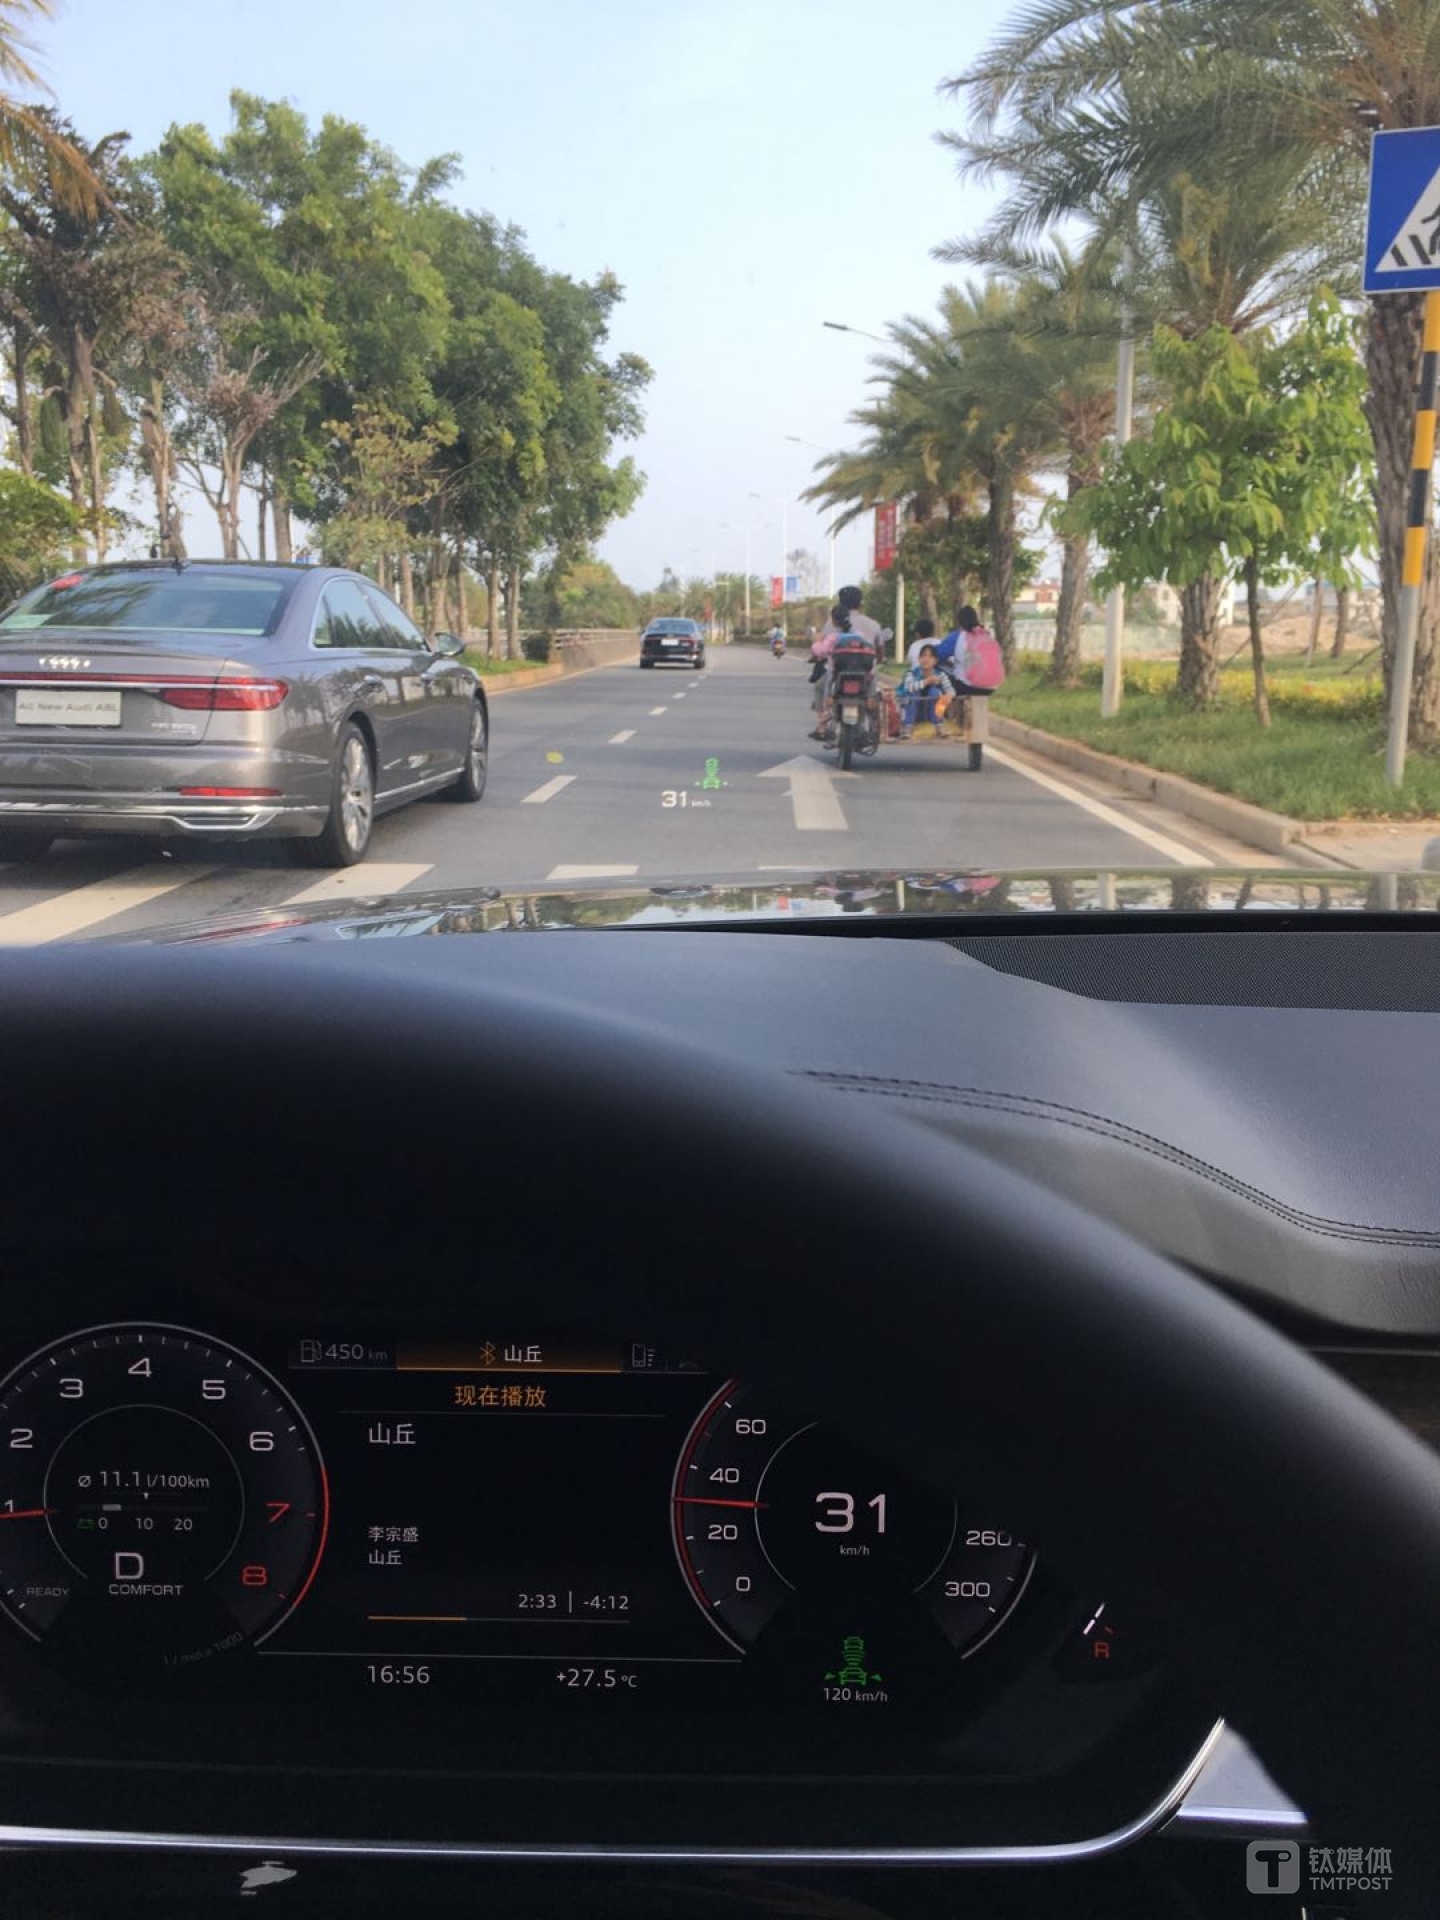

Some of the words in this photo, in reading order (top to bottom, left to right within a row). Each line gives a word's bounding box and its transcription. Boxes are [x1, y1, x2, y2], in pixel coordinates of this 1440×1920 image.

[661, 790, 687, 808] 31
[325, 1343, 364, 1360] 450
[504, 1344, 543, 1363] 山丘
[127, 1357, 153, 1378] 4
[59, 1378, 84, 1399] 3
[202, 1379, 226, 1400] 5
[455, 1385, 546, 1407] 现在播放
[369, 1422, 416, 1445] 山丘
[735, 1418, 766, 1435] 60
[9, 1428, 33, 1449] 2
[249, 1431, 274, 1452] 6
[709, 1467, 740, 1484] 40
[266, 1501, 291, 1522] 7
[815, 1491, 886, 1533] 31
[97, 1516, 108, 1530] 0
[135, 1517, 154, 1530] 10
[174, 1518, 193, 1531] 20
[707, 1524, 738, 1541] 20
[368, 1525, 419, 1542] 李宗盛
[966, 1530, 1012, 1547] 260
[368, 1549, 403, 1565] 山丘
[839, 1545, 870, 1556] km/h
[114, 1551, 144, 1580] D
[242, 1565, 268, 1586] 8
[735, 1576, 751, 1592] 0
[26, 1587, 69, 1597] READY
[108, 1583, 183, 1596] COMFORT
[945, 1581, 991, 1598] 300
[518, 1594, 557, 1609] 2:33
[583, 1595, 629, 1610] -4:12
[1093, 1641, 1110, 1659] R
[367, 1665, 430, 1684] 16:56
[556, 1668, 616, 1688] +27.5
[823, 1687, 852, 1701] 120
[855, 1690, 888, 1702] km/h
